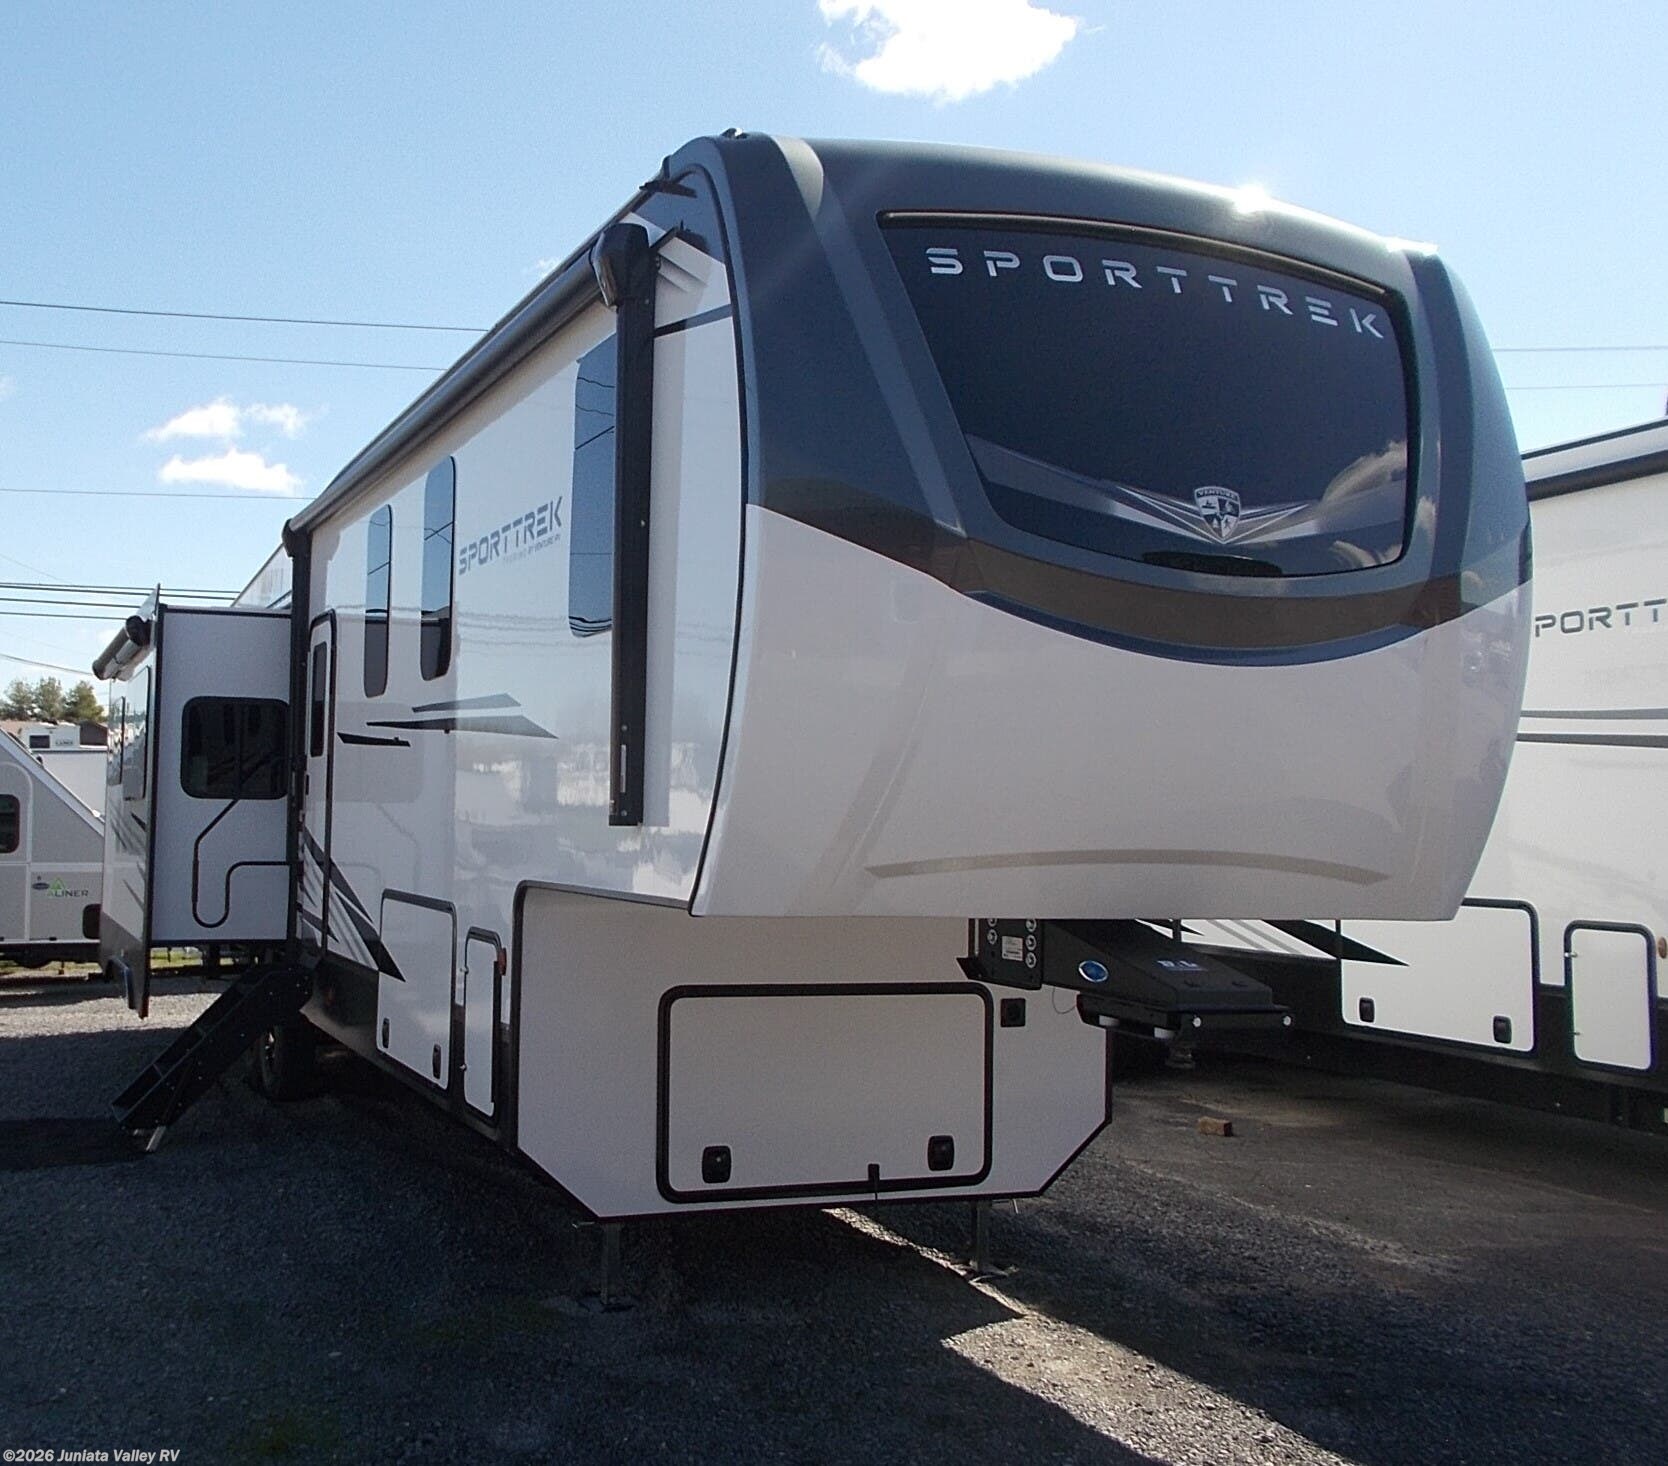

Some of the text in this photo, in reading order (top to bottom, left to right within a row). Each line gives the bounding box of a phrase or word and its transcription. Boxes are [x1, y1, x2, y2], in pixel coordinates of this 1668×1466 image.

[926, 247, 1384, 339] SPORTTREK
[459, 496, 562, 575] SPORTTREK
[47, 889, 89, 898] ALINER
